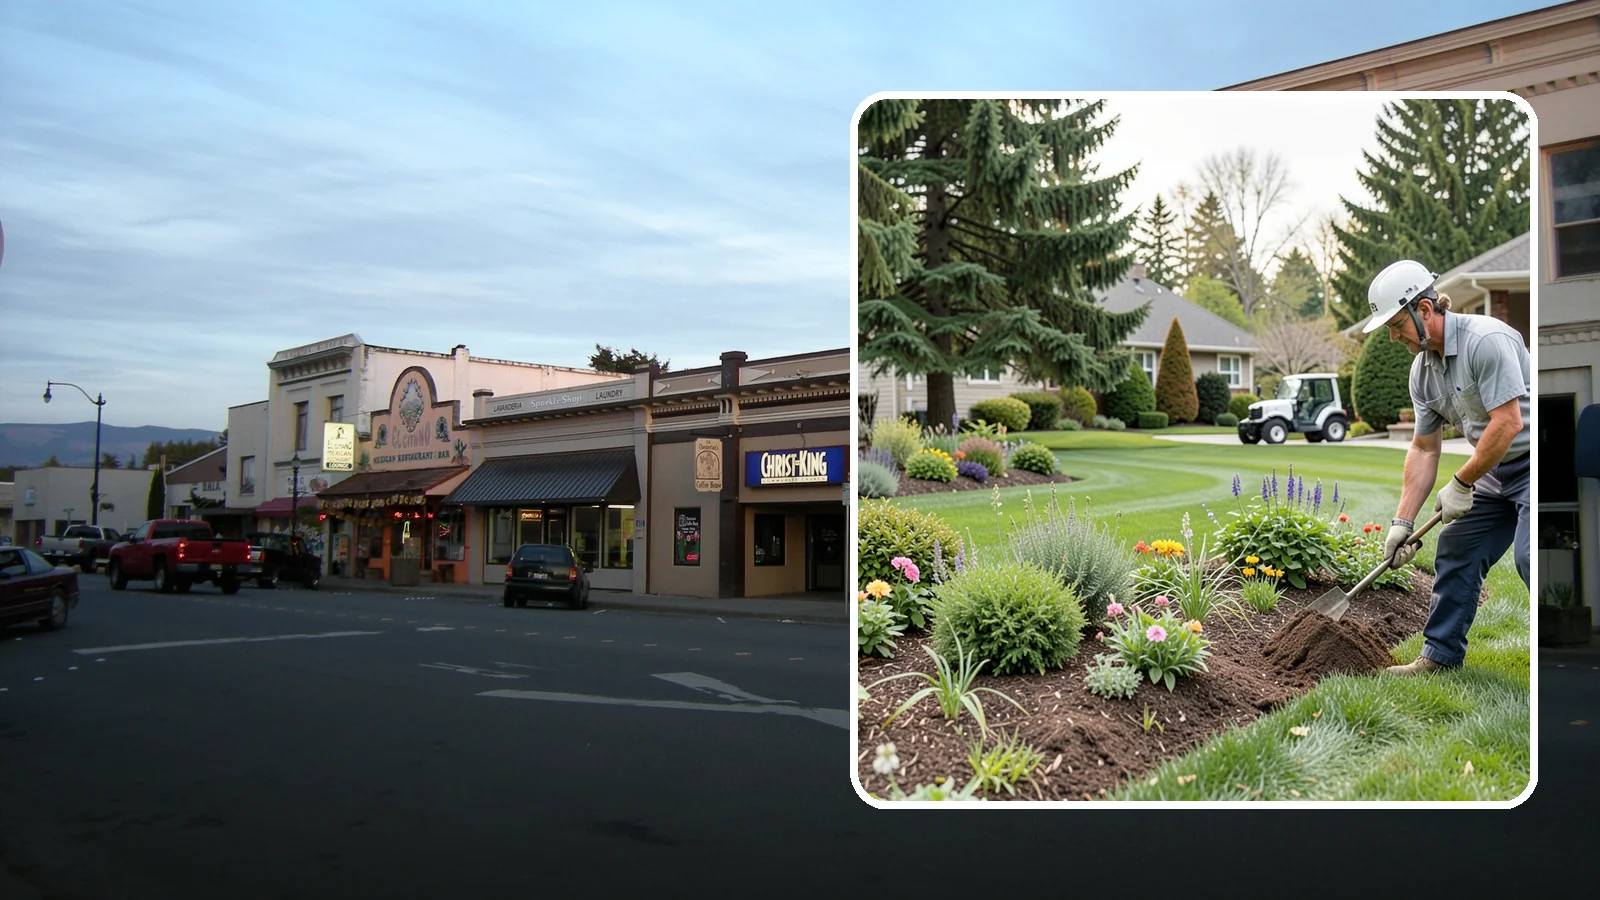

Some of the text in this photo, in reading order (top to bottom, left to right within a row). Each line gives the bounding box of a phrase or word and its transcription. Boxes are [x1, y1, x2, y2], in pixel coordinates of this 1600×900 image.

[595, 389, 623, 400] LAUNDRY
[530, 394, 583, 409] Sparkle Shop
[493, 402, 522, 413] LAVANDERIA
[397, 451, 433, 462] RESTAURANT
[438, 450, 450, 458] BAR
[761, 450, 827, 478] CHRIST KING
[696, 481, 709, 489] Coffee
